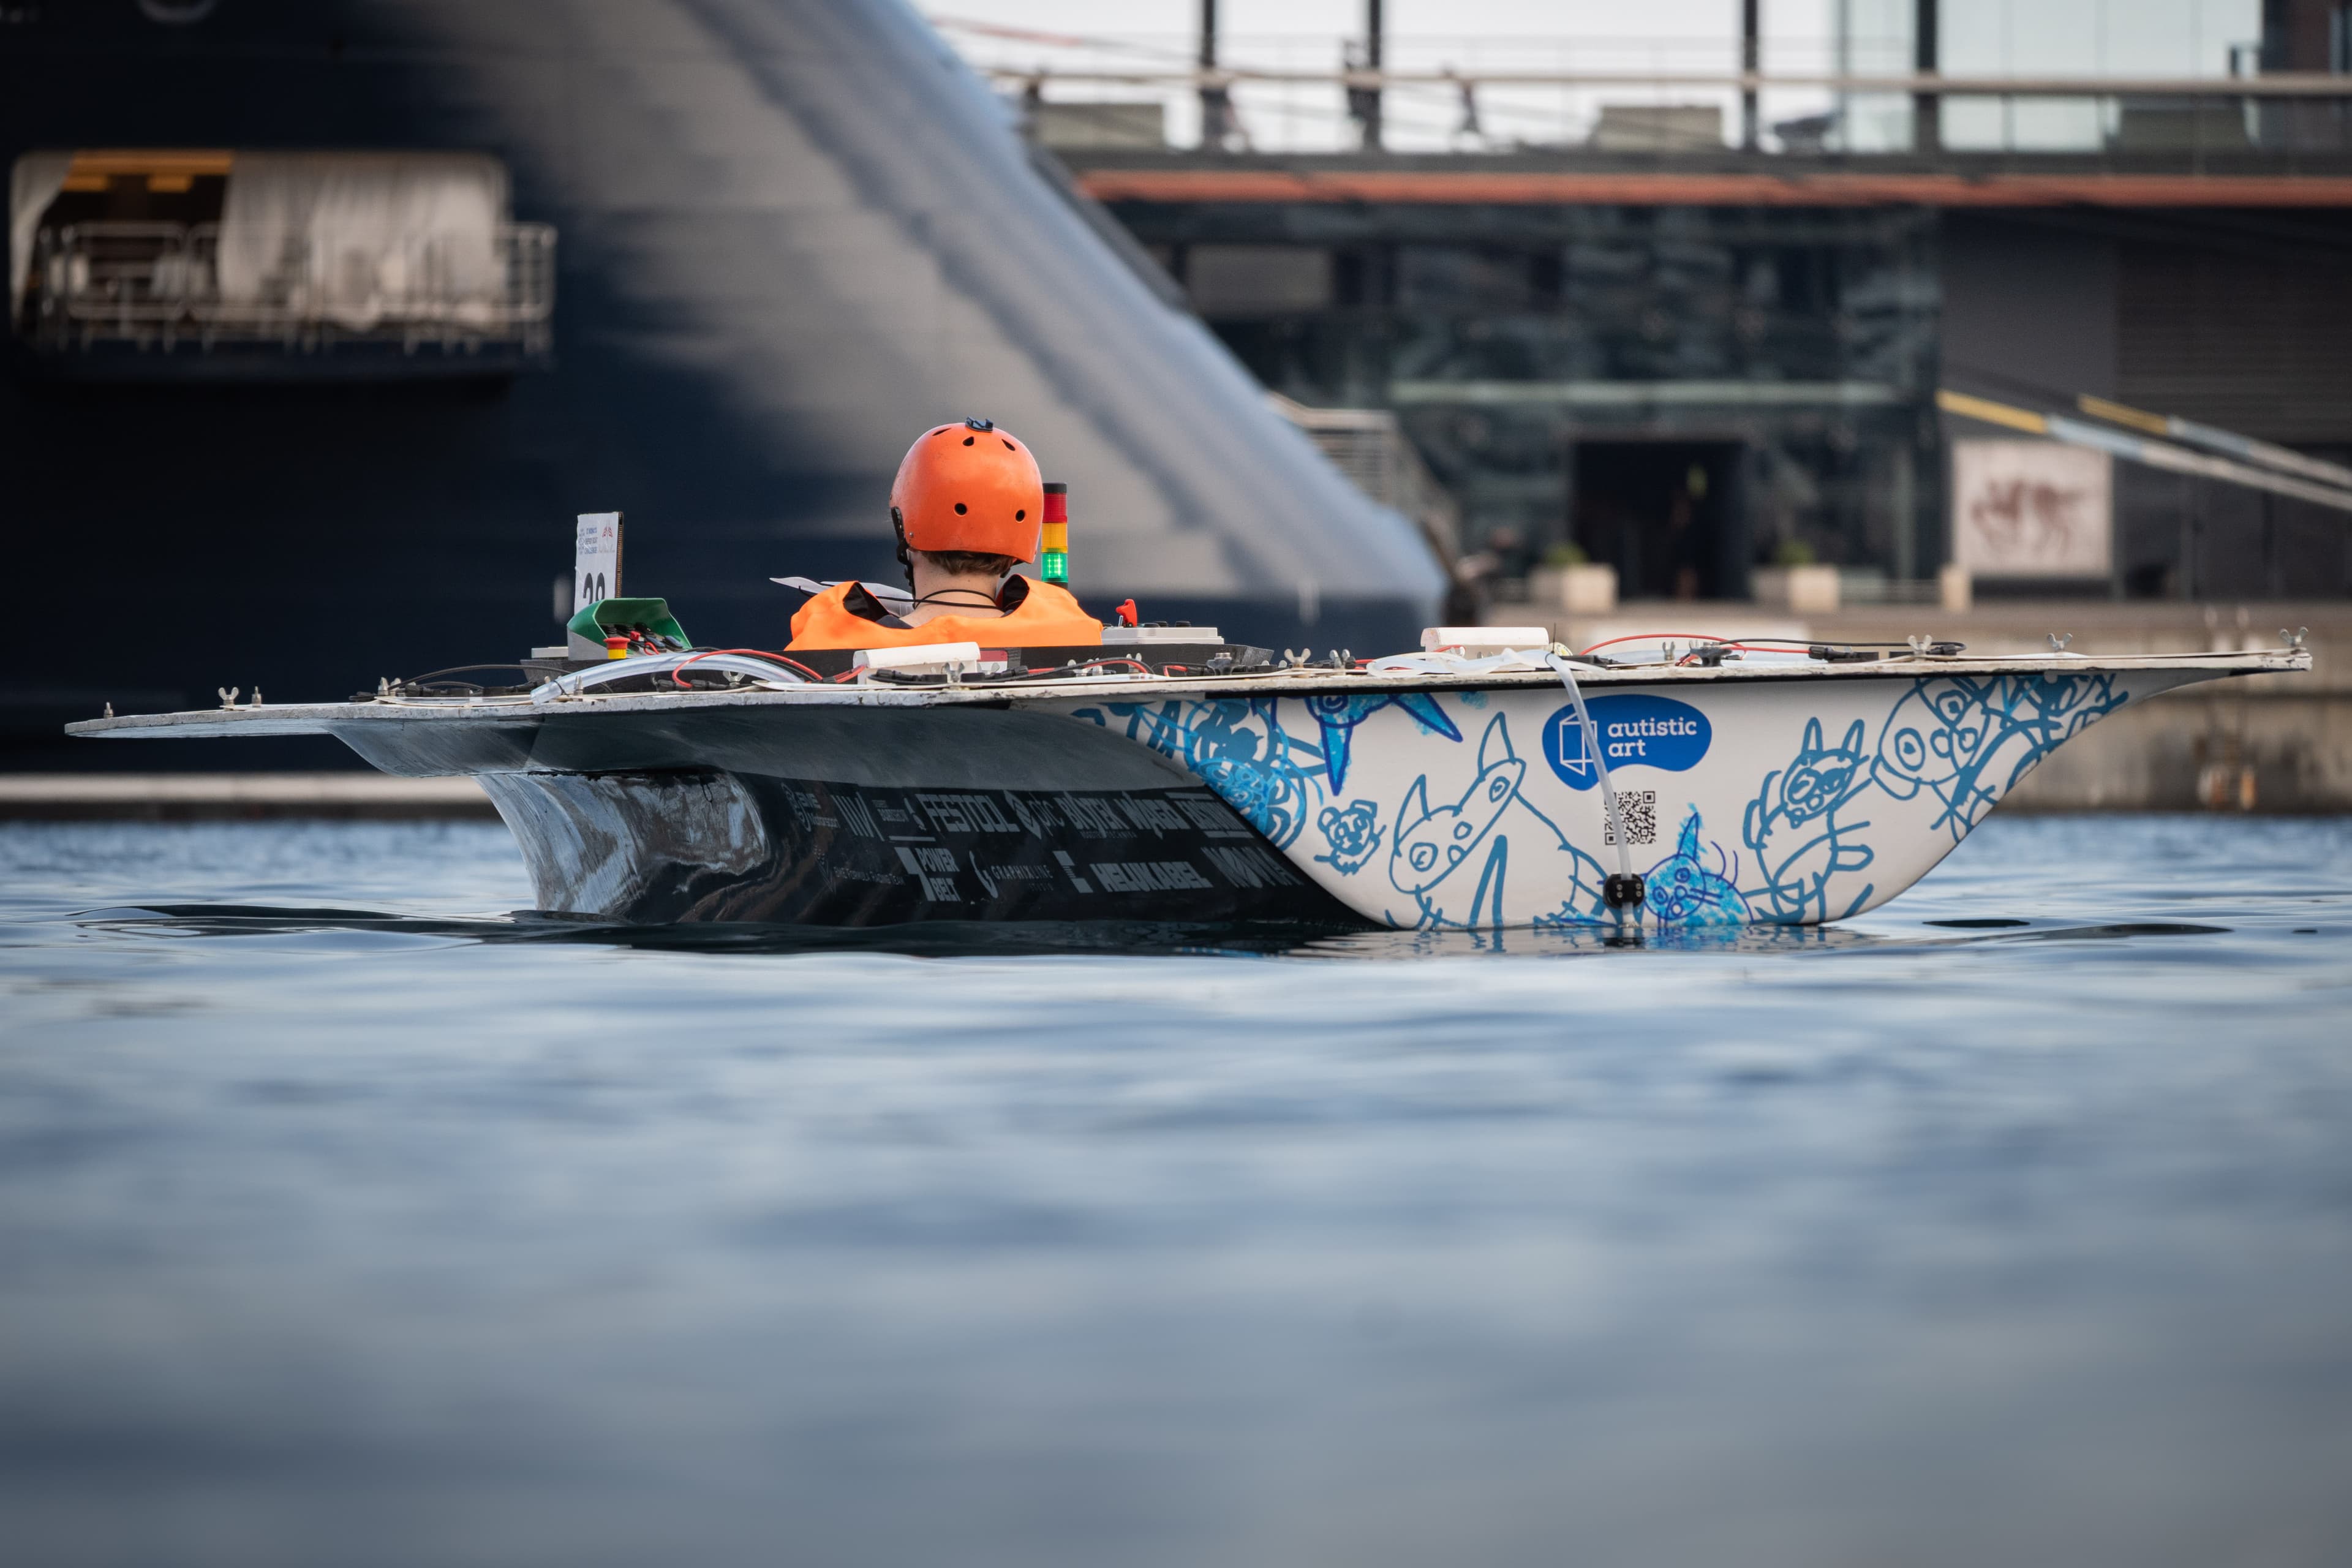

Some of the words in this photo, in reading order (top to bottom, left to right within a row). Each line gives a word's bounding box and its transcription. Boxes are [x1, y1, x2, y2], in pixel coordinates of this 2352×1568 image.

[1607, 717, 1697, 737] autistic
[1608, 739, 1646, 757] art
[915, 793, 1021, 832] FESTOOL
[915, 848, 960, 872] POWER
[1089, 861, 1214, 892] HELUKABEL
[929, 878, 961, 902] BELT
